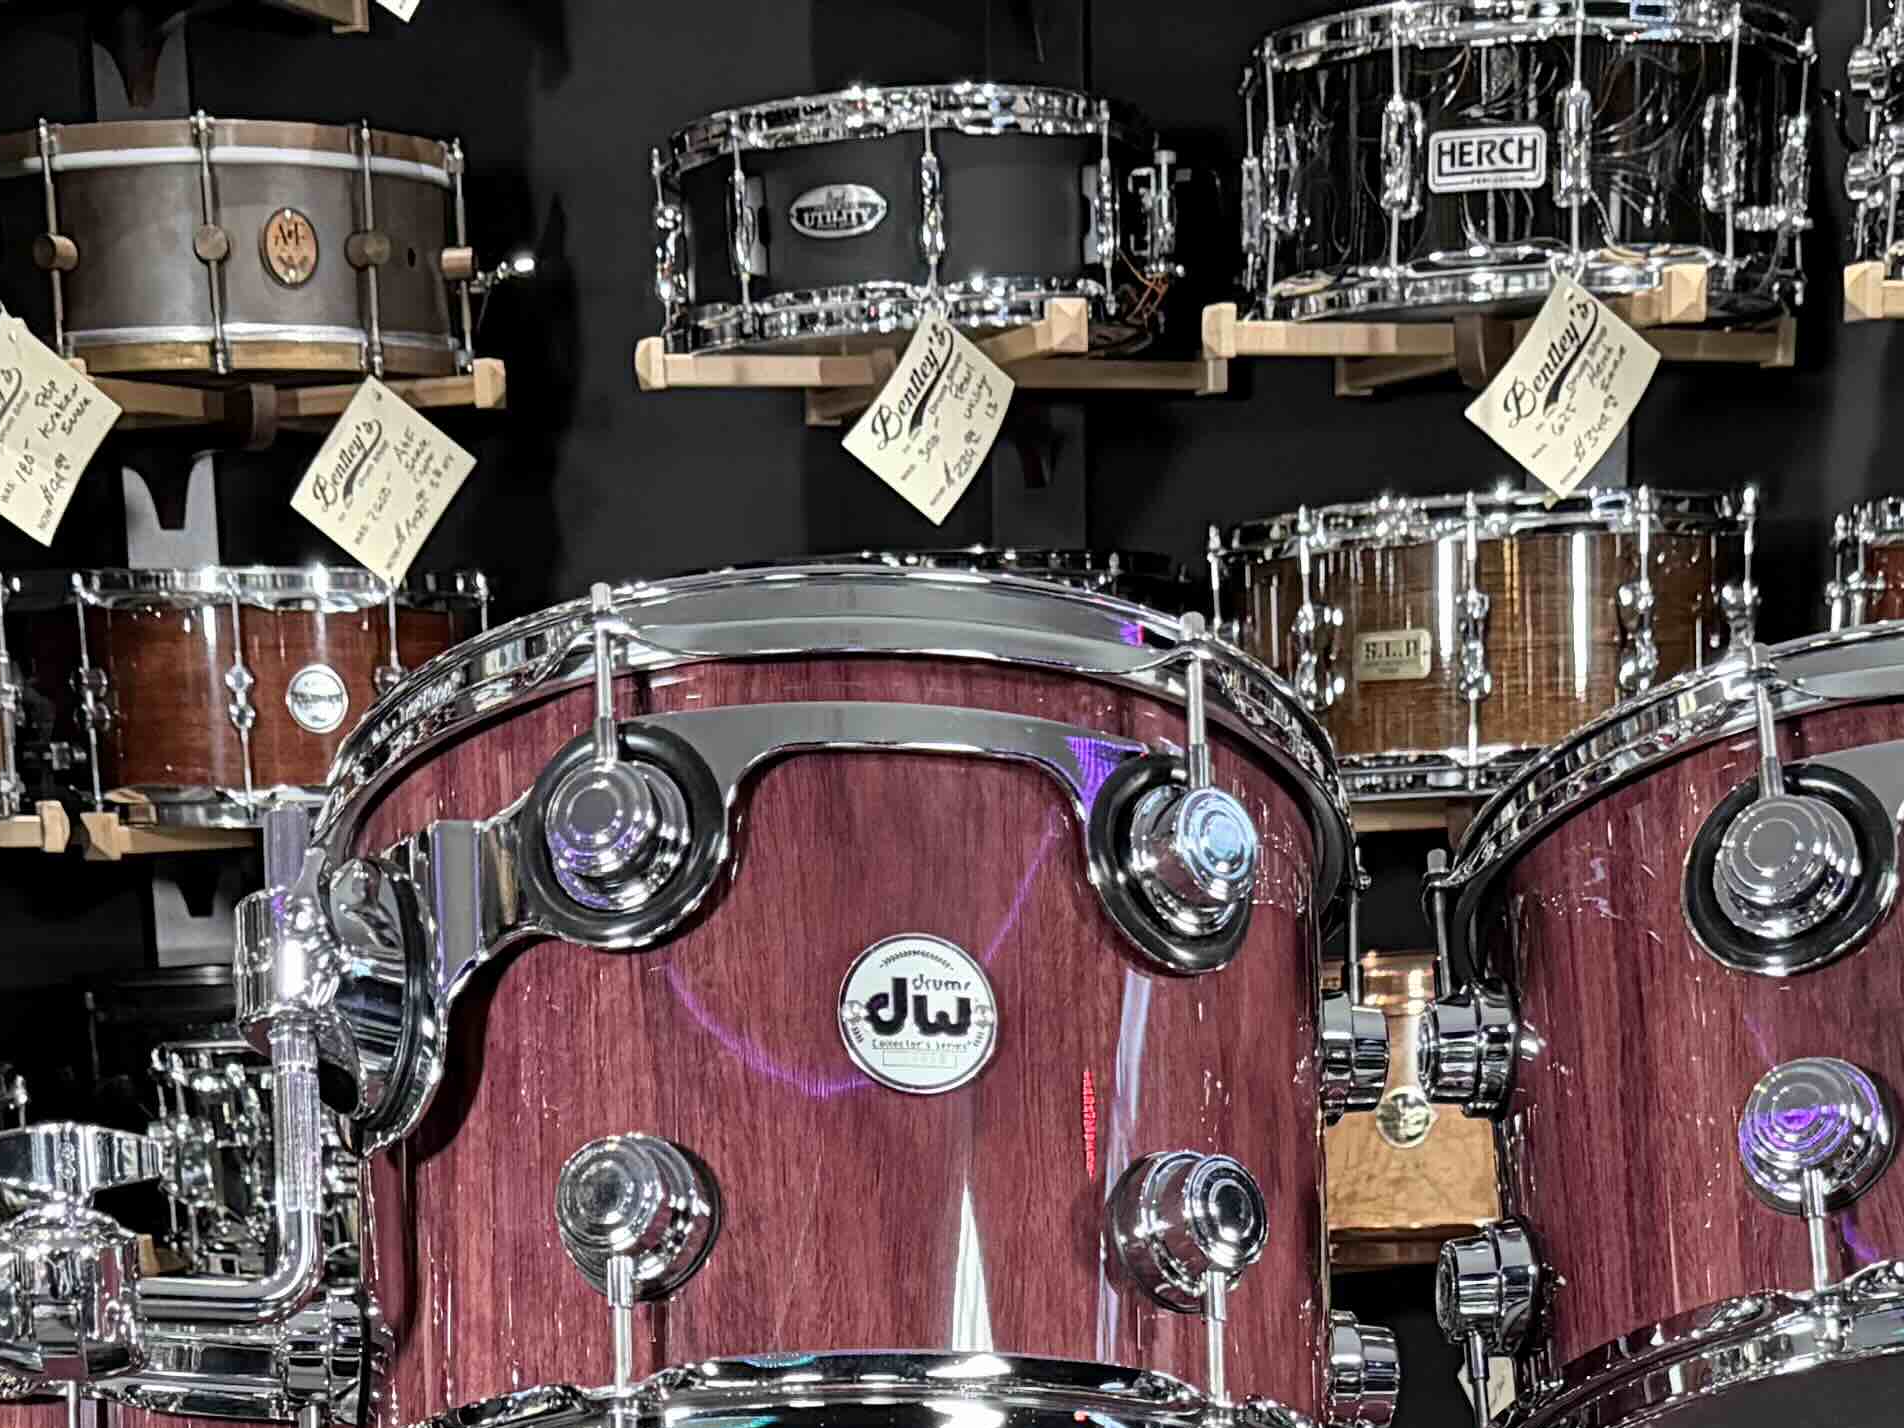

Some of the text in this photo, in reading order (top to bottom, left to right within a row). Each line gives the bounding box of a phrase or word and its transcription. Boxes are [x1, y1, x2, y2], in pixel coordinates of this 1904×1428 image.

[1437, 136, 1537, 170] HERCH
[871, 323, 955, 450] Bentley's
[1503, 299, 1599, 429] Bentley's
[312, 418, 383, 513] Bentley's
[864, 977, 972, 1036] dw
[912, 974, 971, 992] drums
